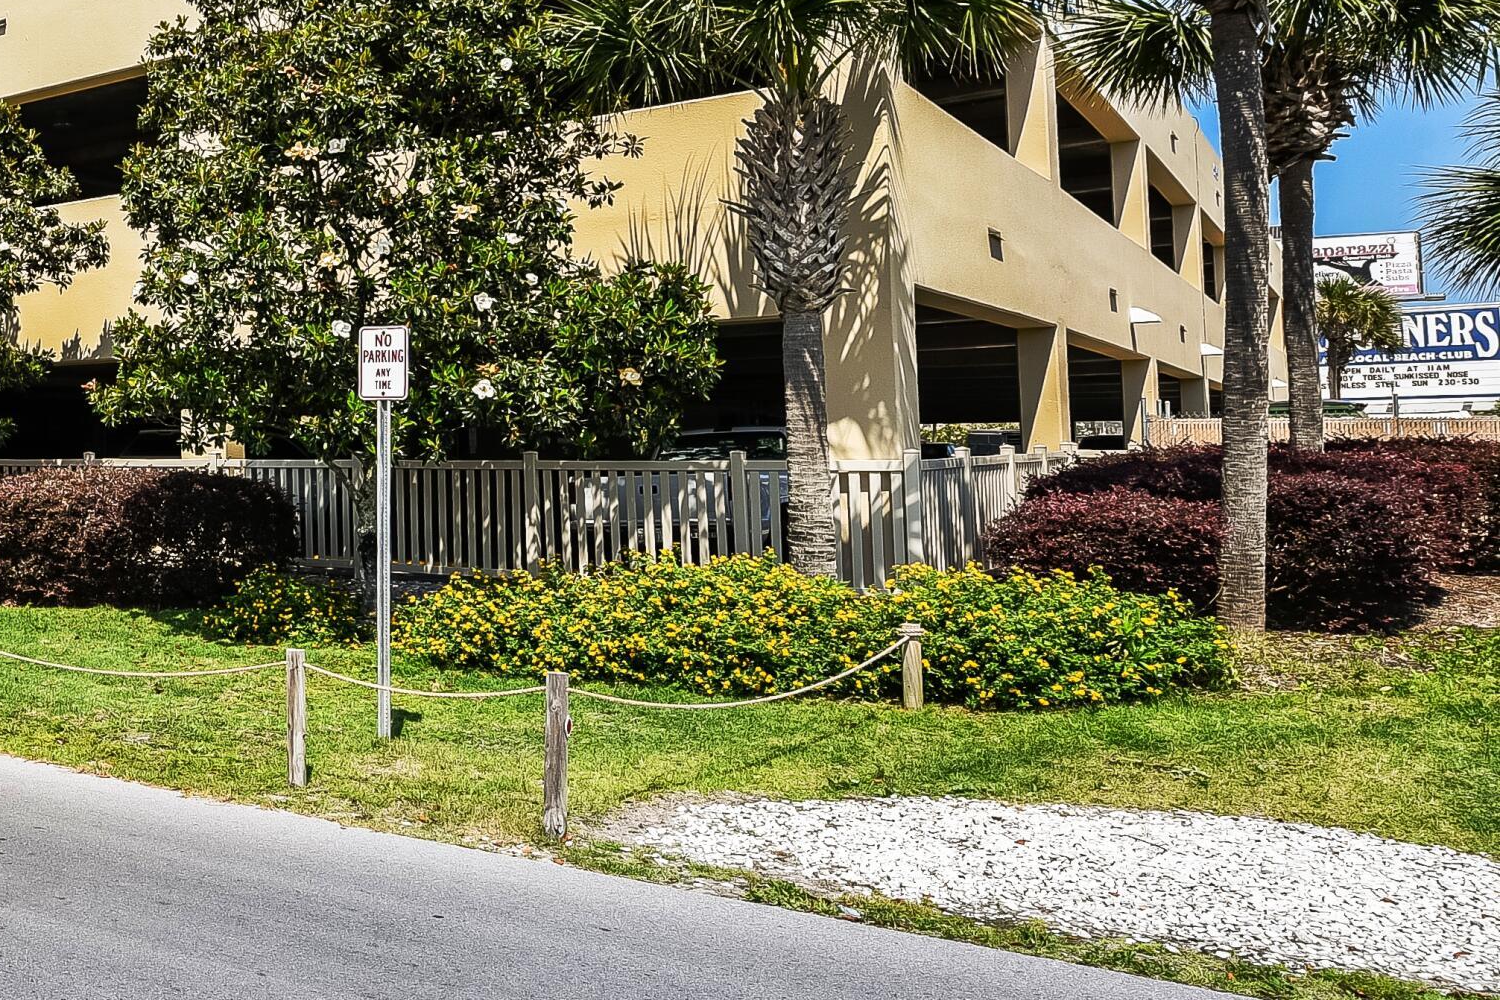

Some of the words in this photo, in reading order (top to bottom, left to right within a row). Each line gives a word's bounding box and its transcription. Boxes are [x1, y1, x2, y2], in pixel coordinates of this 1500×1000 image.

[1312, 237, 1397, 262] aparazzi
[1314, 271, 1340, 279] elivery
[375, 334, 392, 347] NO
[363, 349, 404, 363] PARKING
[375, 368, 391, 377] ANY
[1369, 366, 1396, 374] DAILY
[1393, 372, 1440, 380] SUNKISSED
[374, 380, 392, 390] TIME
